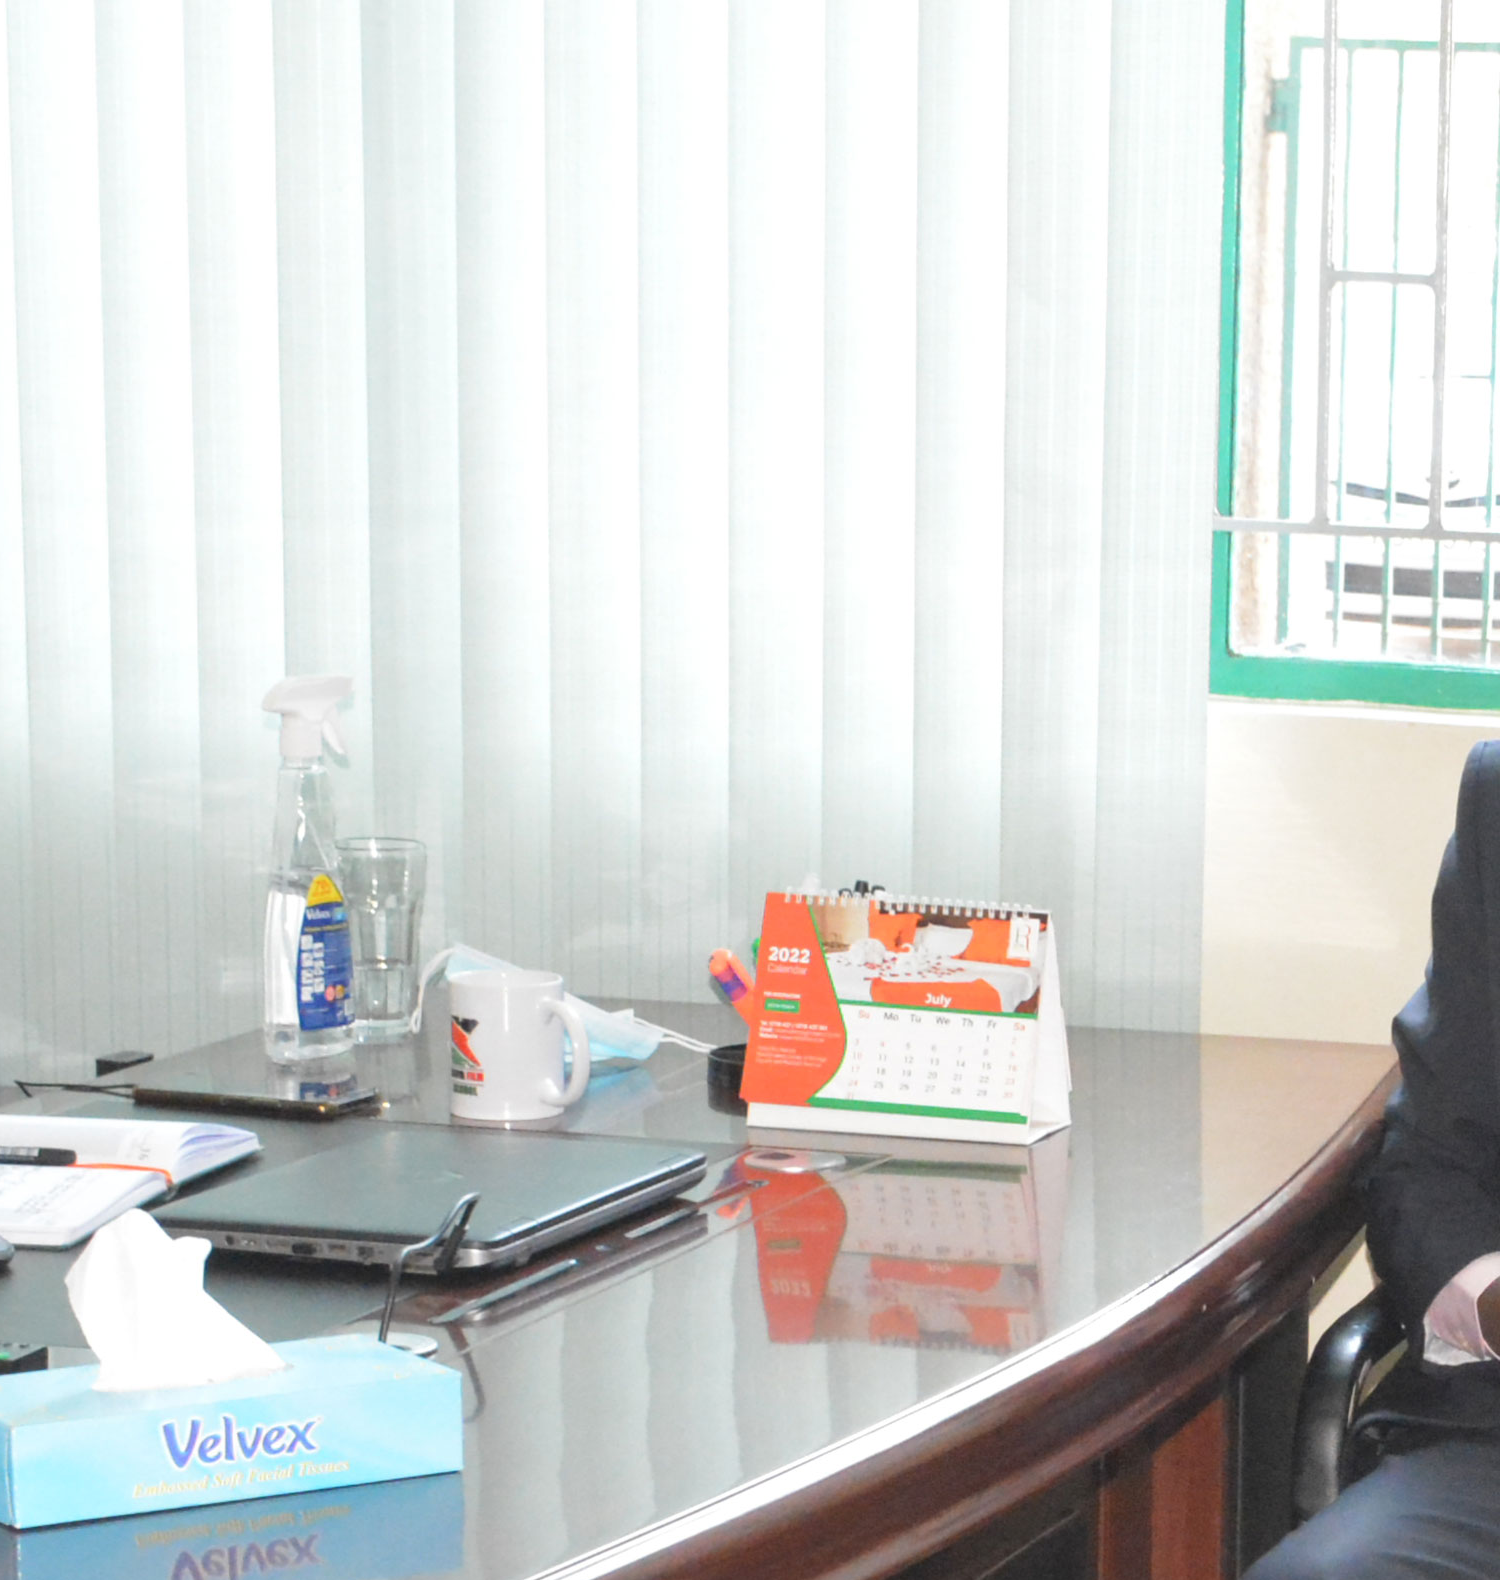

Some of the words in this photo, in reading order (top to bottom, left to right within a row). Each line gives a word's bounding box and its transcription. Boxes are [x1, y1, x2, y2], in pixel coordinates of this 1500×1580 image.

[768, 946, 810, 964] 2022
[925, 993, 952, 1008] July
[859, 1010, 870, 1019] Su
[884, 1012, 899, 1021] Mo
[910, 1014, 921, 1023] Tu
[936, 1016, 950, 1025] We
[962, 1018, 973, 1027] Th
[987, 1020, 996, 1029] Fr
[1014, 1023, 1025, 1031] Sa
[161, 1415, 317, 1469] Velvex
[133, 1475, 209, 1498] Embossed
[212, 1468, 244, 1489] Soft
[248, 1464, 294, 1484] Facial
[298, 1460, 350, 1478] Tissues
